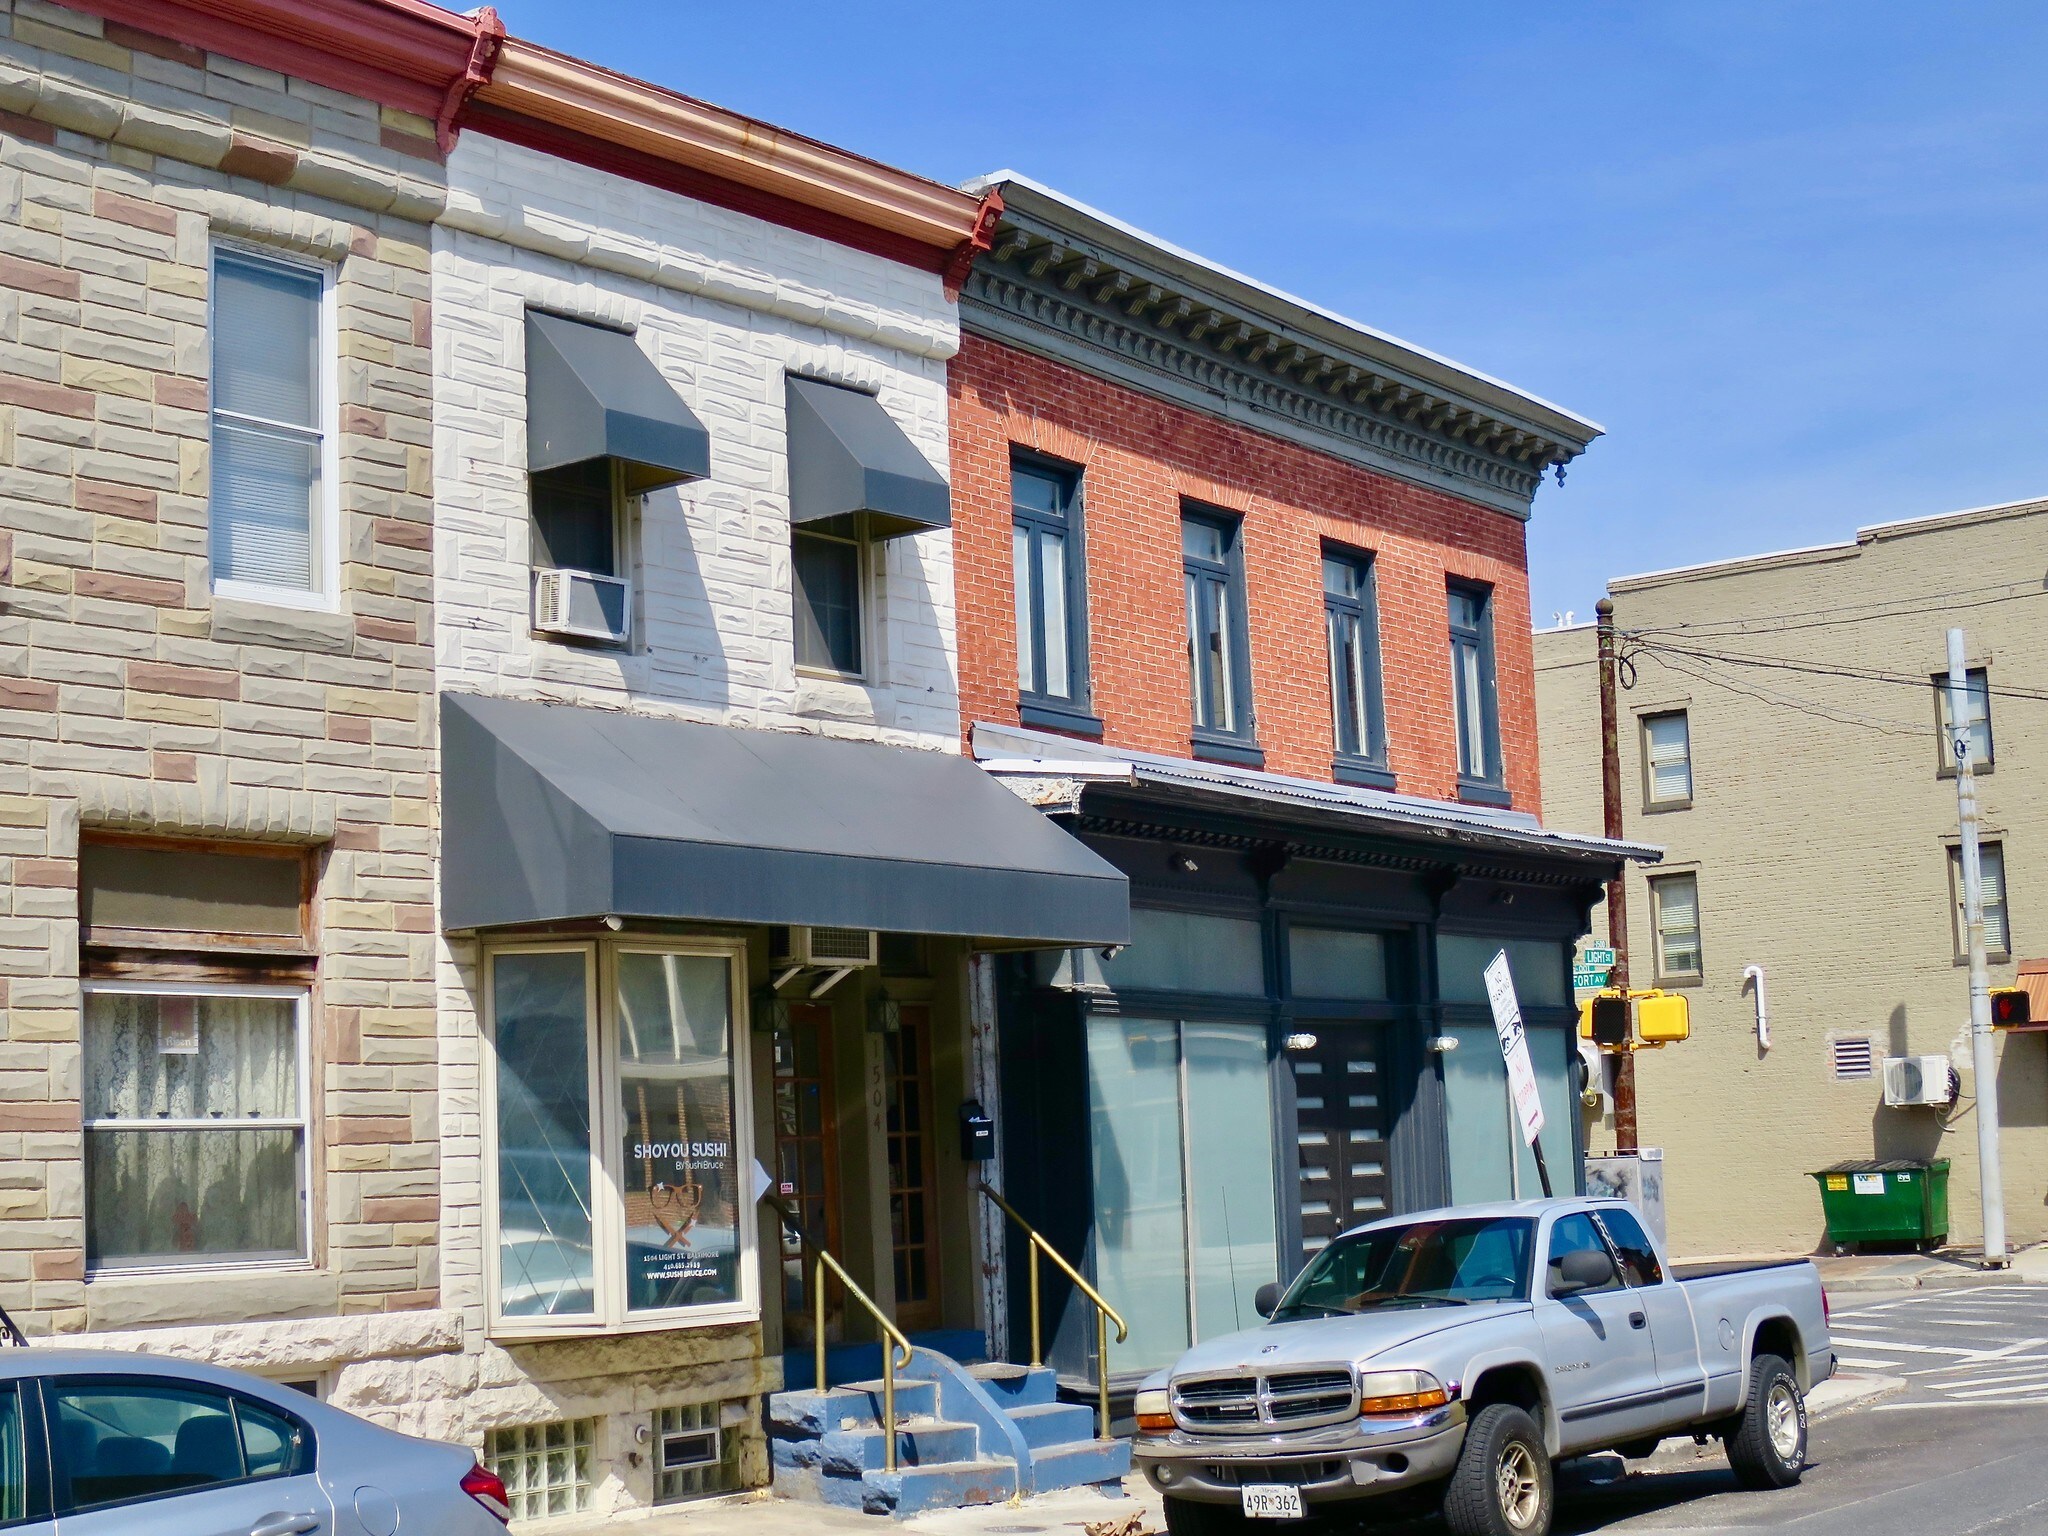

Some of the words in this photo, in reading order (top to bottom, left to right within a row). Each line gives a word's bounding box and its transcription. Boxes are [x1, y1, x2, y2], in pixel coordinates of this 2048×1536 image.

[1587, 951, 1605, 963] LIGHT
[1573, 974, 1594, 987] FORT
[873, 1039, 882, 1133] 1504
[634, 1143, 689, 1159] SHOYOU
[692, 1142, 727, 1157] SUSHI
[658, 1253, 676, 1261] LIGHT
[676, 1252, 686, 1260] ST.
[686, 1250, 719, 1259] BALTIMORE
[1247, 1494, 1268, 1511] 49R
[1275, 1494, 1298, 1511] 362
